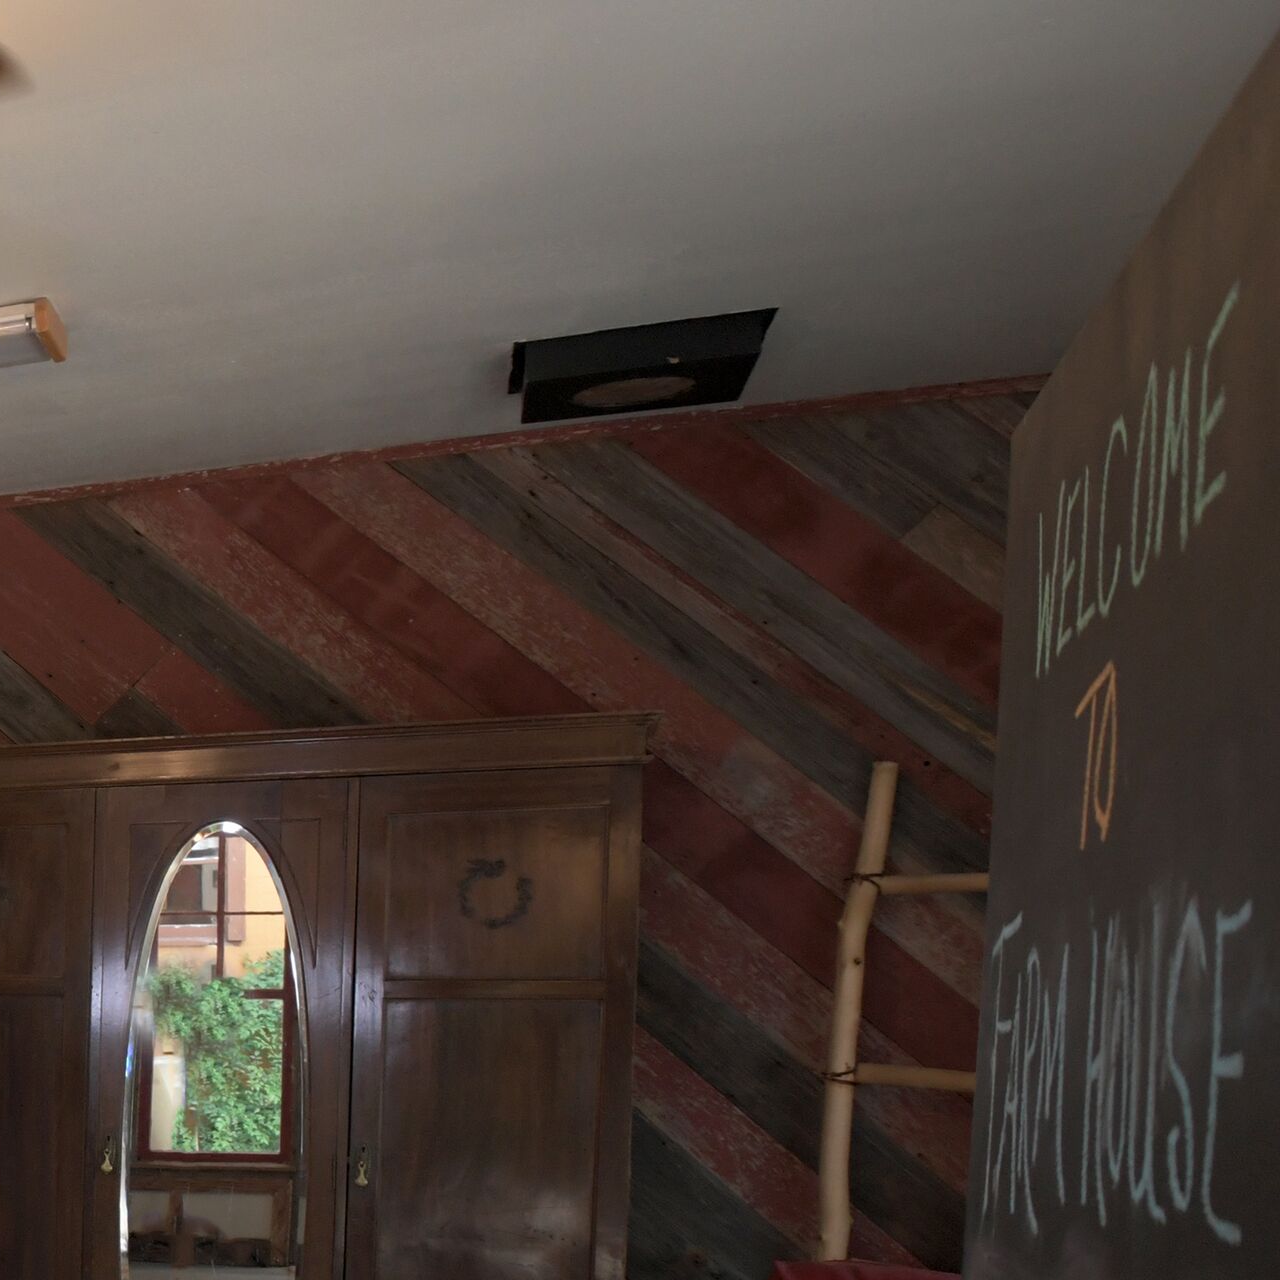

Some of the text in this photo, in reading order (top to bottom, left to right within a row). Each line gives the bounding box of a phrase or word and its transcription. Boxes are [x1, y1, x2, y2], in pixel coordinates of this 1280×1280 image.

[1036, 280, 1239, 679] WELCOME
[1075, 658, 1118, 851] TO
[980, 898, 1252, 1245] FARM HOUSE
